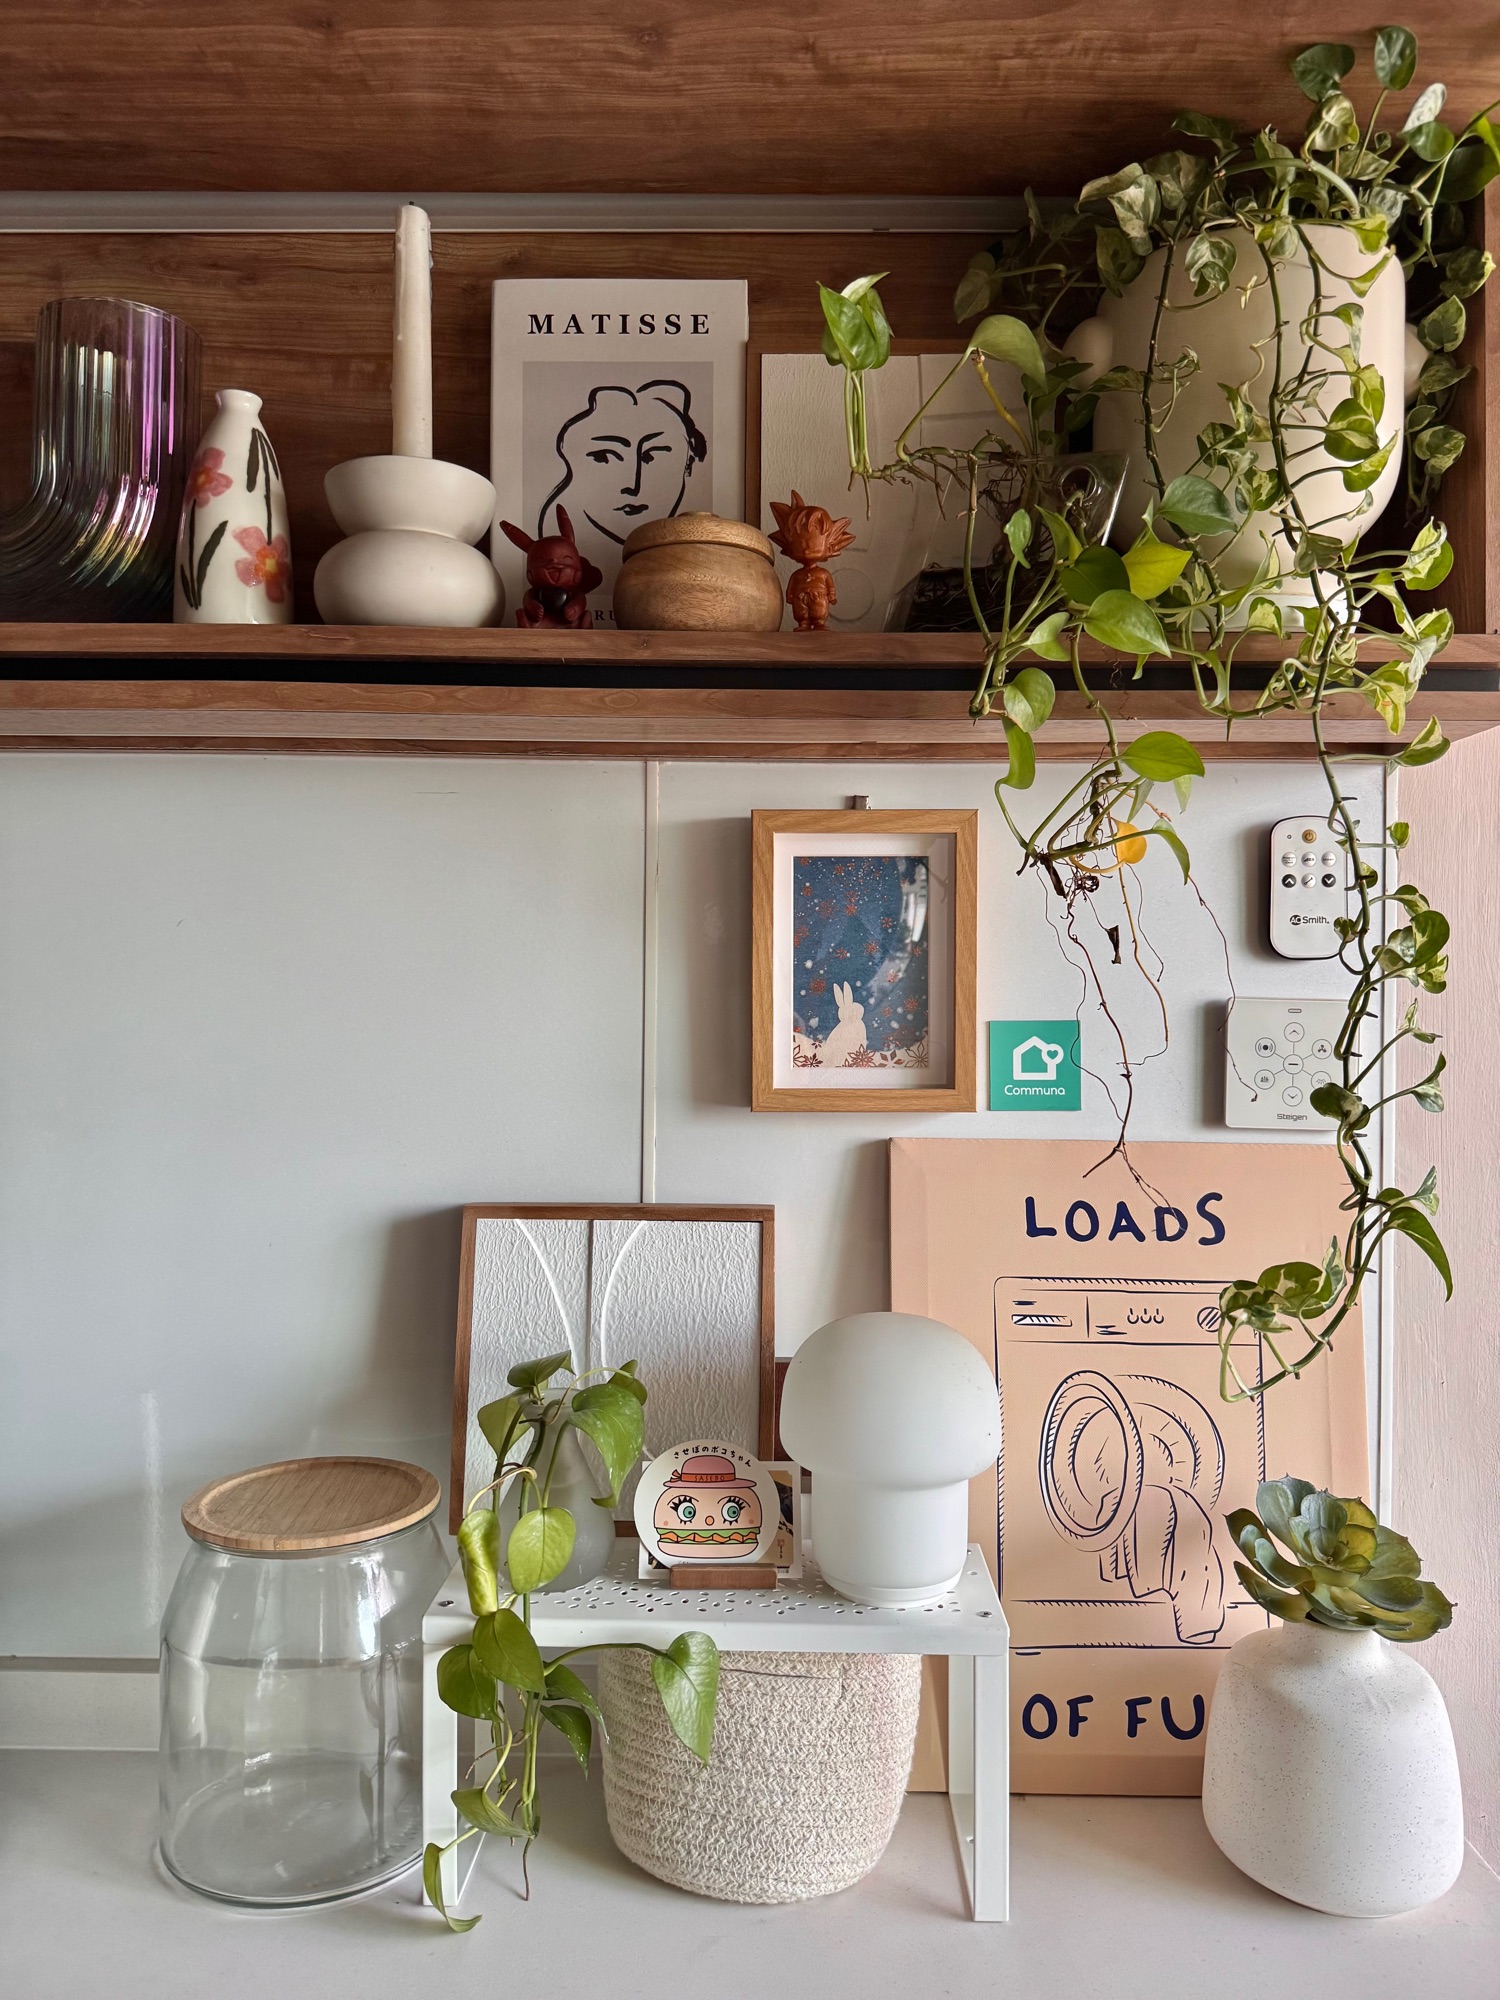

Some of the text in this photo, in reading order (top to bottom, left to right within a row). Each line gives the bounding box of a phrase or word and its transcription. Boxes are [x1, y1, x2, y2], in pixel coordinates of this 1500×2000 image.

[527, 313, 710, 335] MATISSE
[1004, 1084, 1066, 1096] Communa
[1276, 1113, 1308, 1122] Steigen
[1025, 1192, 1226, 1246] LOADS
[1022, 1693, 1094, 1741] OF
